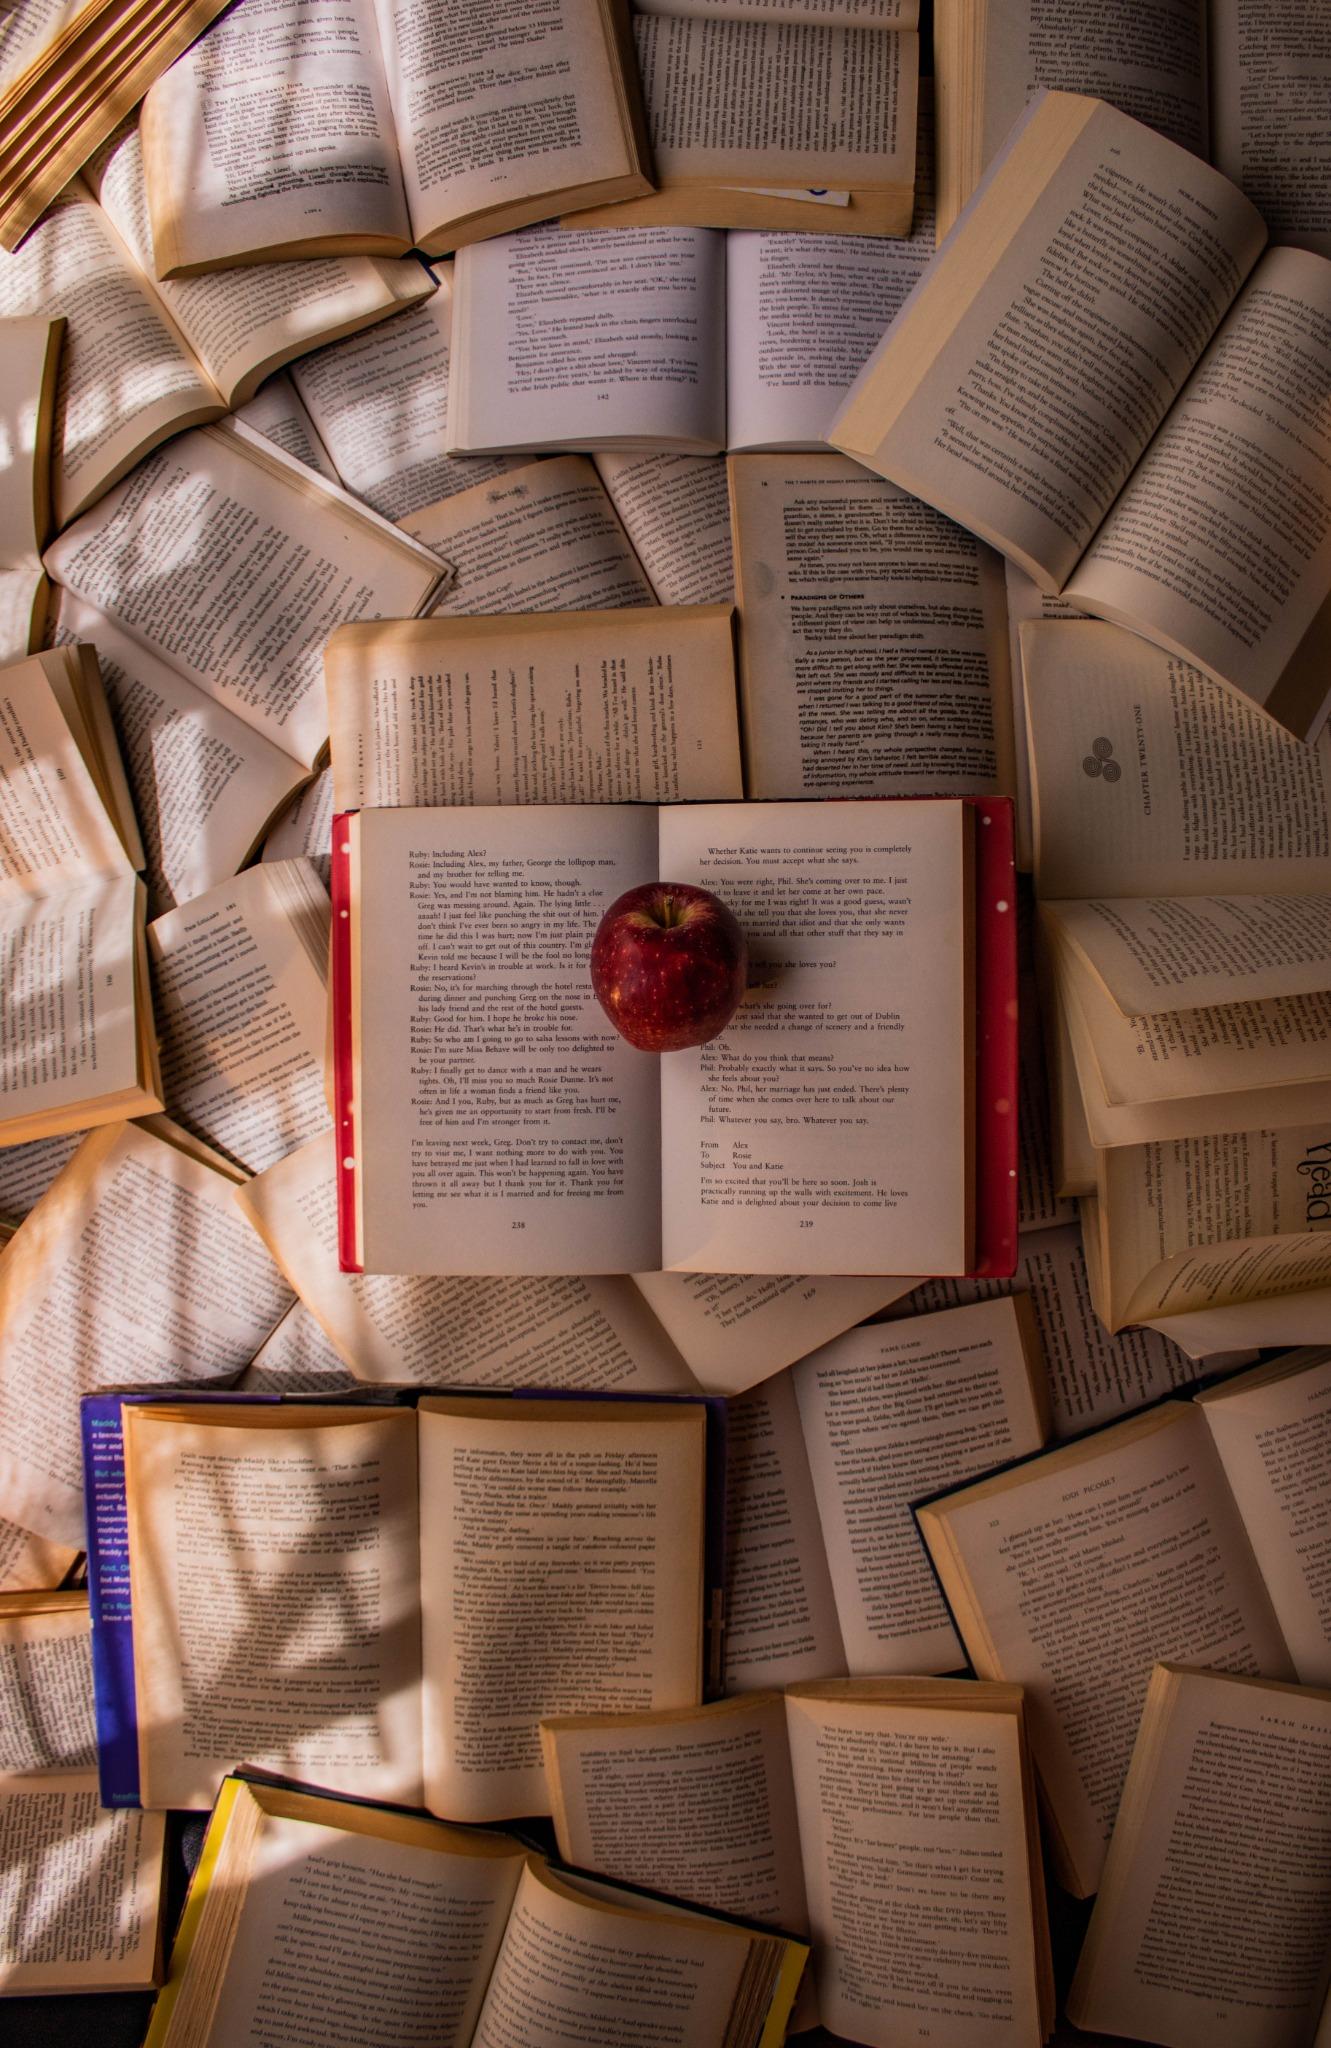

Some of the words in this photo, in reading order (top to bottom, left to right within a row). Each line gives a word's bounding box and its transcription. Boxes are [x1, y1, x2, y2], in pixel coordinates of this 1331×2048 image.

[1133, 704, 1146, 766] TWENTY-ONE
[1139, 770, 1151, 816] CHAPTER
[409, 849, 429, 860] Ruby:
[432, 849, 464, 860] Including
[467, 849, 487, 857] Alex?
[708, 846, 737, 854] Whether
[738, 846, 757, 854] Katie
[760, 846, 781, 854] wants
[783, 846, 790, 854] to
[792, 845, 823, 853] continue
[825, 845, 847, 856] seeing
[865, 845, 871, 853] is
[873, 844, 912, 855] completely
[409, 860, 430, 868] Rosie:
[432, 859, 465, 870] Including
[468, 859, 486, 870] Alex,
[502, 859, 524, 869] father,
[526, 858, 552, 869] George
[554, 858, 565, 866] the
[568, 858, 595, 869] lollipop
[699, 857, 710, 865] her
[712, 857, 743, 865] decision.
[745, 857, 760, 865] You
[762, 856, 779, 864] must
[782, 856, 804, 867] accept
[807, 856, 824, 864] what
[827, 856, 839, 864] she
[409, 880, 430, 891] Ruby:
[433, 880, 446, 888] You
[449, 879, 471, 888] would
[473, 879, 490, 887] have
[492, 879, 518, 887] wanted
[520, 879, 528, 887] to
[530, 878, 552, 889] know,
[554, 878, 581, 889] though.
[410, 1014, 430, 1025] Ruby:
[433, 1014, 453, 1022] Good
[456, 1014, 466, 1022] for
[468, 1014, 484, 1022] him.
[492, 1013, 510, 1024] hope
[512, 1013, 521, 1021] he
[523, 1013, 544, 1021] broke
[546, 1013, 557, 1021] his
[700, 1115, 715, 1123] Phil:
[718, 1115, 751, 1123] Whatever
[754, 1118, 767, 1126] you
[769, 1118, 782, 1126] say,
[785, 1115, 799, 1123] bro.
[801, 1115, 836, 1123] Whatever
[411, 1138, 423, 1146] I'm
[425, 1138, 450, 1148] leaving
[452, 1137, 468, 1145] next
[470, 1137, 491, 1148] week,
[493, 1137, 512, 1148] Greg.
[515, 1137, 536, 1145] Don't
[538, 1137, 548, 1147] try
[560, 1136, 586, 1144] contact
[589, 1139, 602, 1147] me,
[604, 1136, 623, 1144] don't
[700, 1140, 719, 1148] From
[700, 1150, 710, 1158] To
[733, 1151, 752, 1159] Rosie
[700, 1161, 725, 1171] Subject
[733, 1161, 746, 1169] You
[748, 1161, 762, 1169] and
[764, 1162, 784, 1170] Katie
[413, 1202, 427, 1210] you.
[99, 1432, 123, 1440] teenag
[854, 1727, 863, 1735] to
